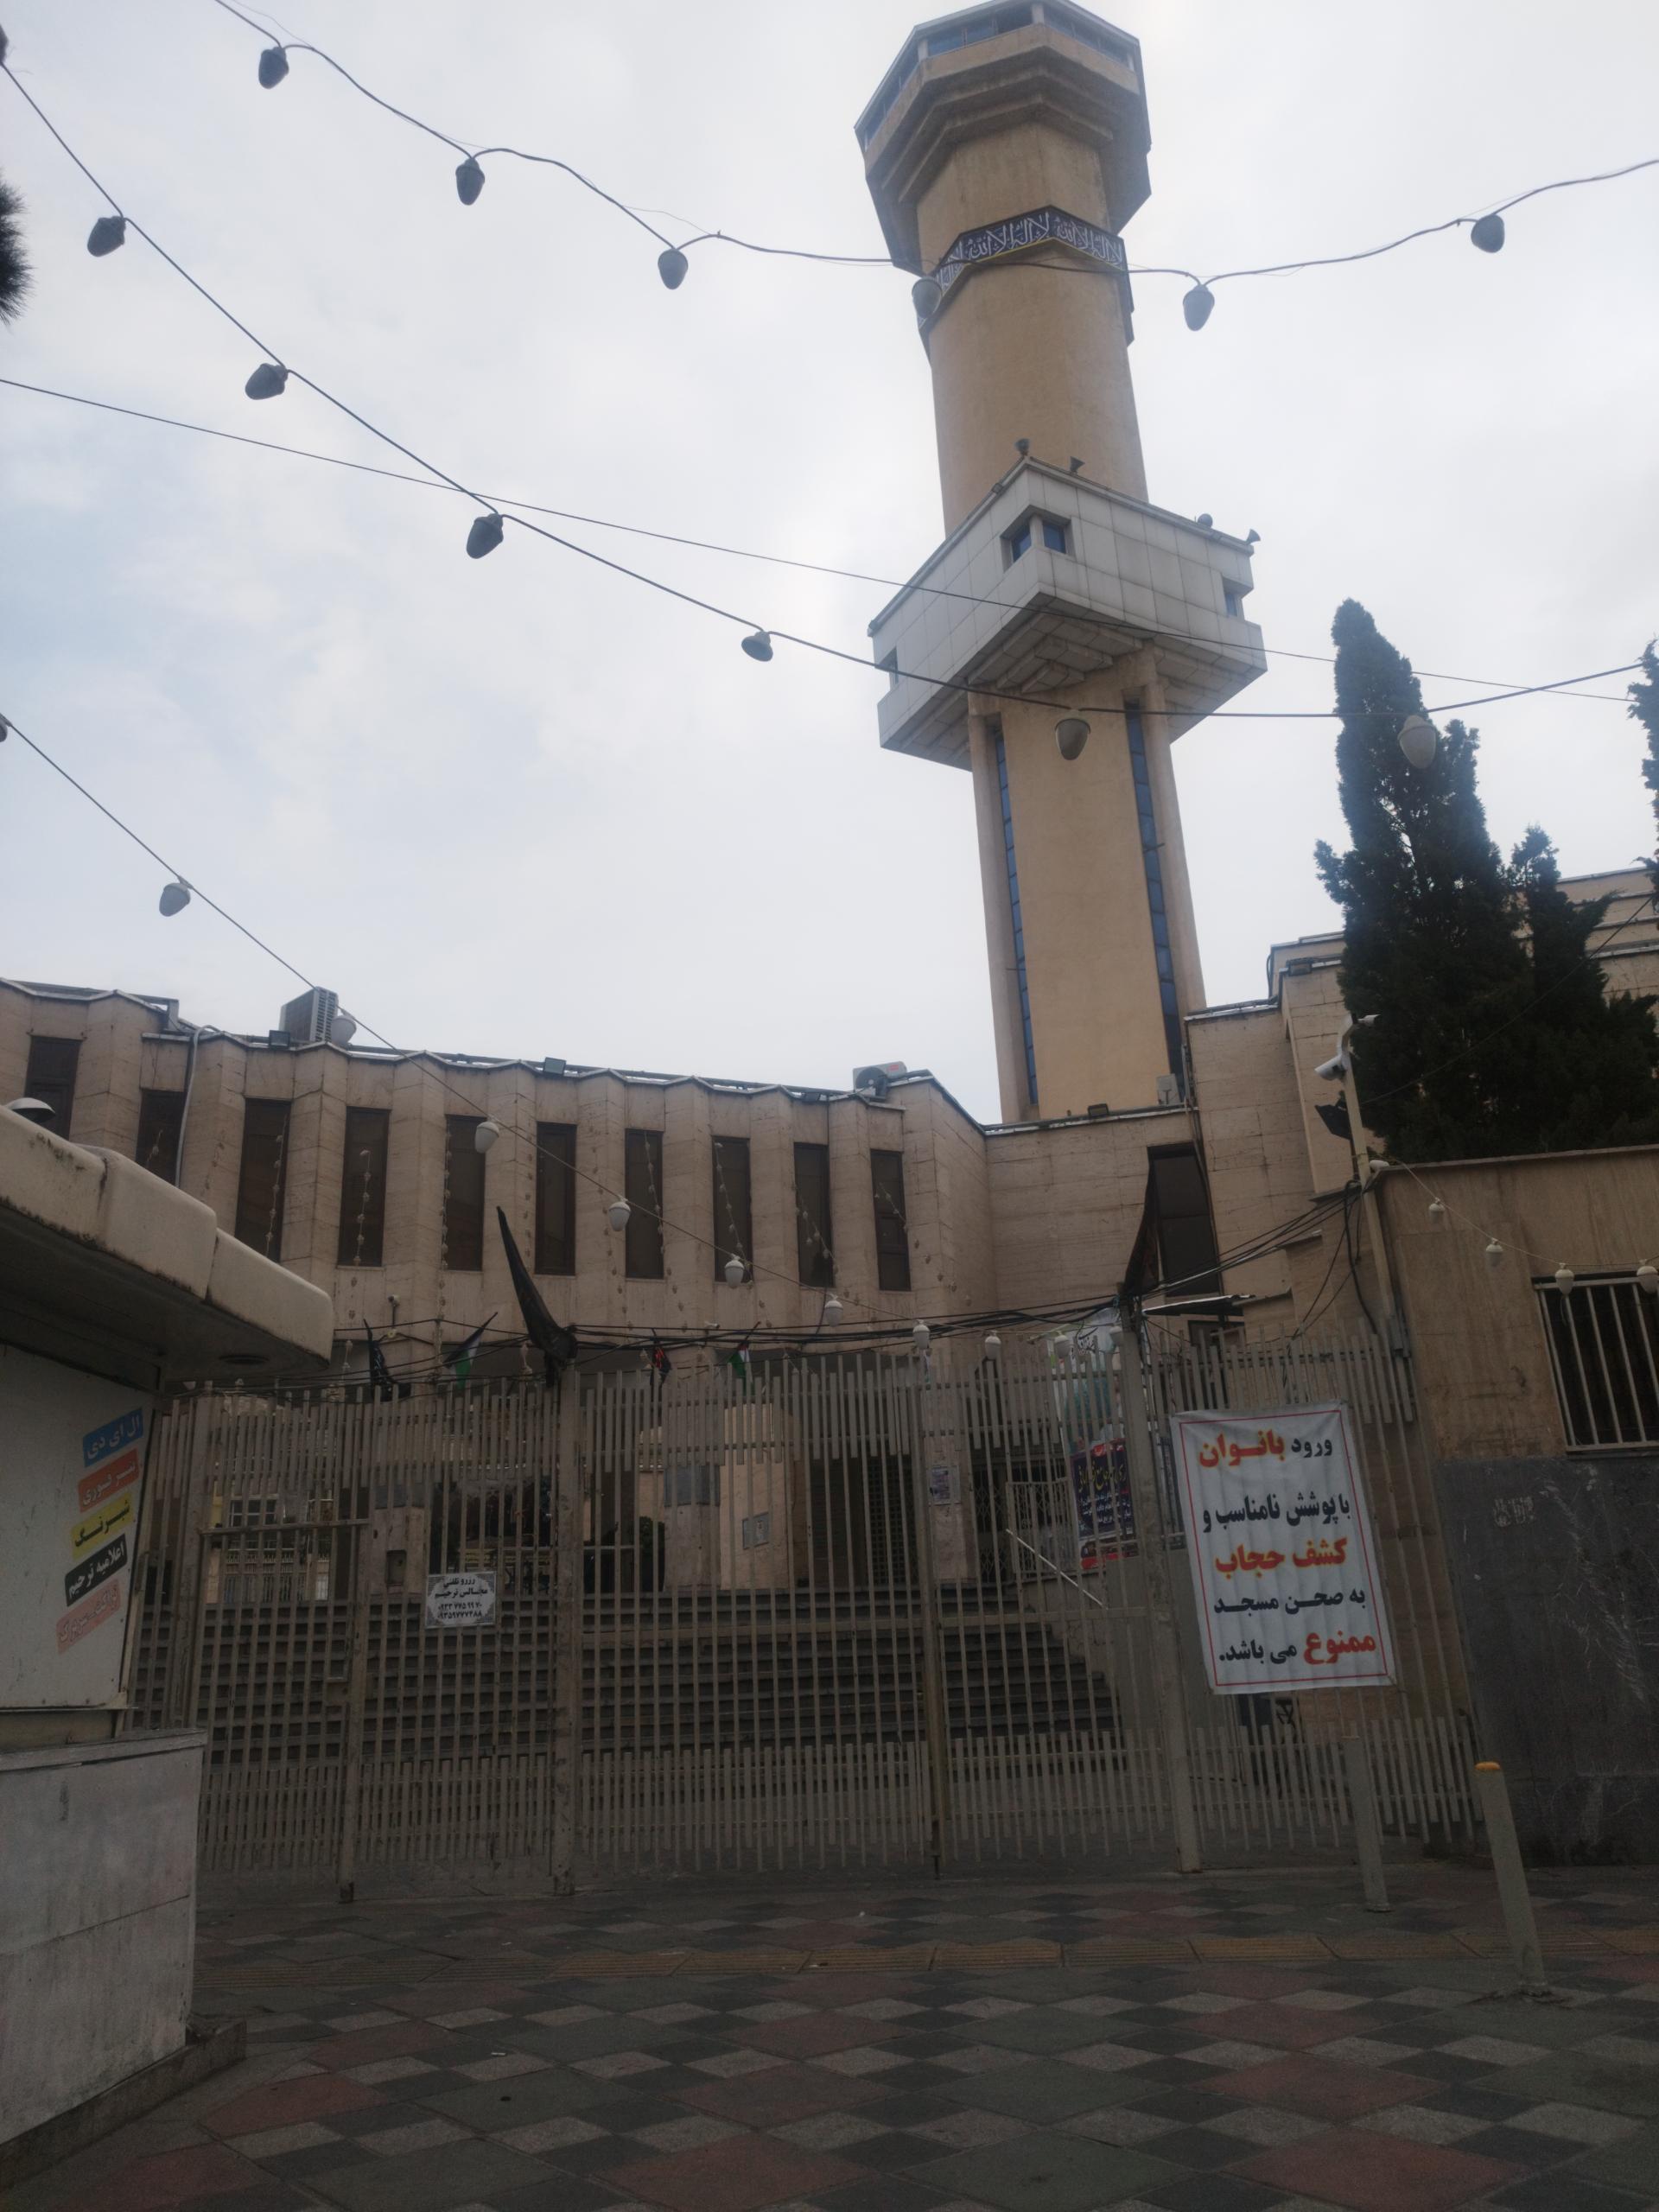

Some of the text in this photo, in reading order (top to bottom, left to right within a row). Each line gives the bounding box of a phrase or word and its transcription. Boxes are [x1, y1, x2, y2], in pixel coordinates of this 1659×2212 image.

[1027, 213, 1049, 243] لا
[967, 235, 991, 260] الله
[87, 1414, 139, 1459] ال ای دی
[1198, 1430, 1332, 1467] ورود بانوان
[82, 1473, 111, 1506] فوری
[1202, 1491, 1351, 1533] با پوشش نامناسب و
[69, 1541, 124, 1599] اعلامیه ترحیم
[1214, 1537, 1348, 1580] کشف حجاب
[460, 1587, 488, 1599] مجالس
[1213, 1589, 1366, 1618] به صحن مسجد
[1219, 1630, 1376, 1665] ممنوع می باشد.
